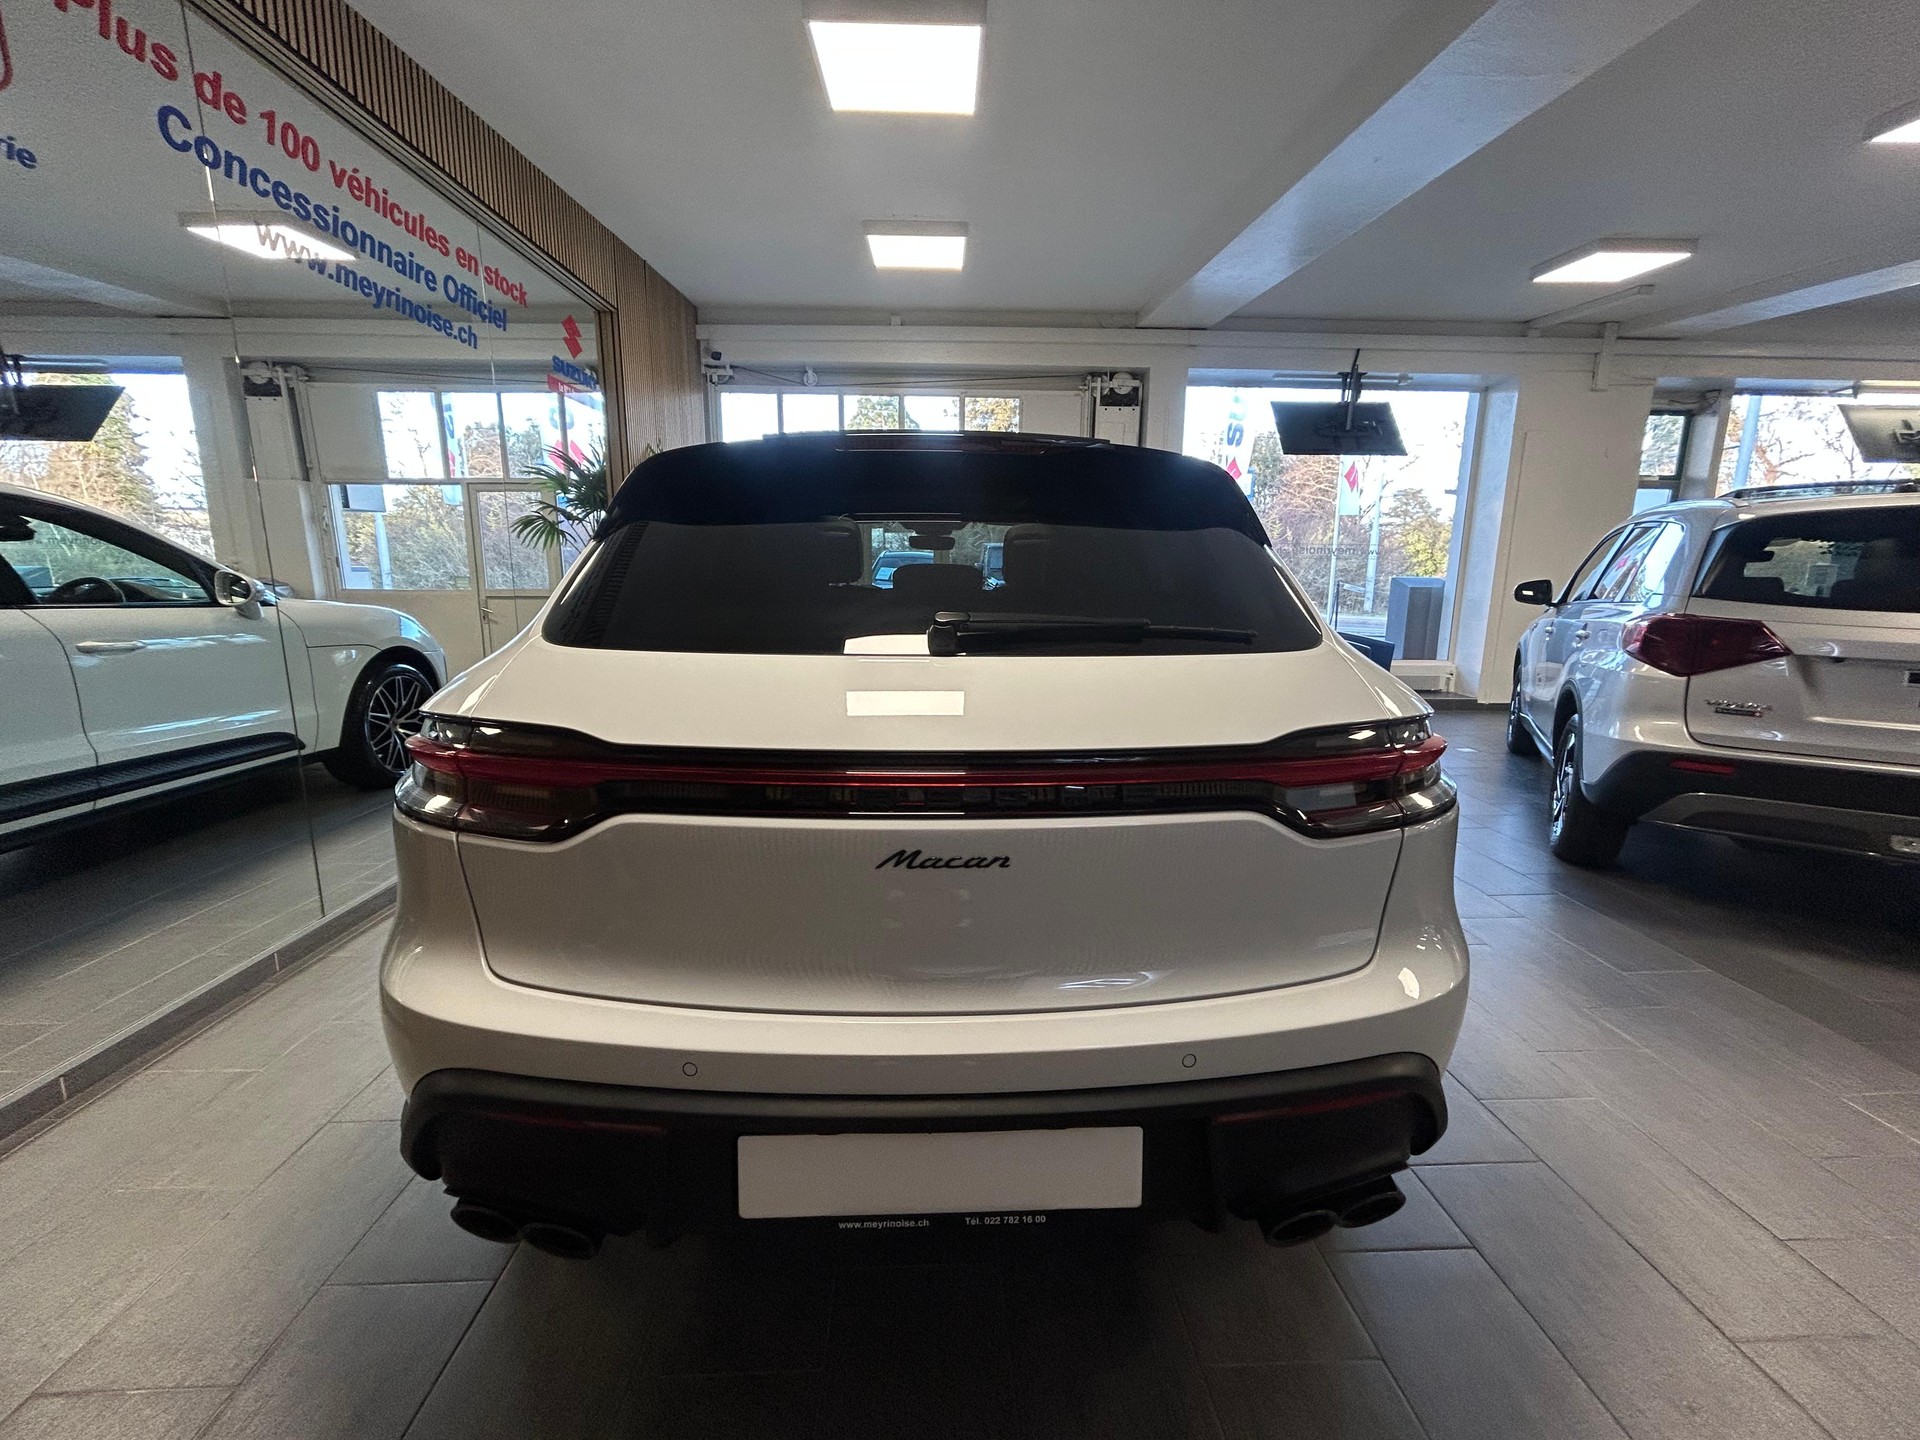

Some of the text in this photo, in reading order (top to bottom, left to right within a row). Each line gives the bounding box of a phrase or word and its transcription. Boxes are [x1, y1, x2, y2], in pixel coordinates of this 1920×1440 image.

[53, 0, 529, 308] lus de 100 véhicules en stock
[157, 104, 508, 332] Concessionnaire Officiel
[252, 219, 478, 350] www.meyrinoise.ch
[874, 848, 1011, 870] Macan
[838, 1218, 930, 1230] www.meyrinoise.ch
[984, 1216, 1001, 1225] 022
[1003, 1215, 1020, 1224] 782
[1022, 1215, 1033, 1224] 16
[1035, 1215, 1047, 1223] 00
